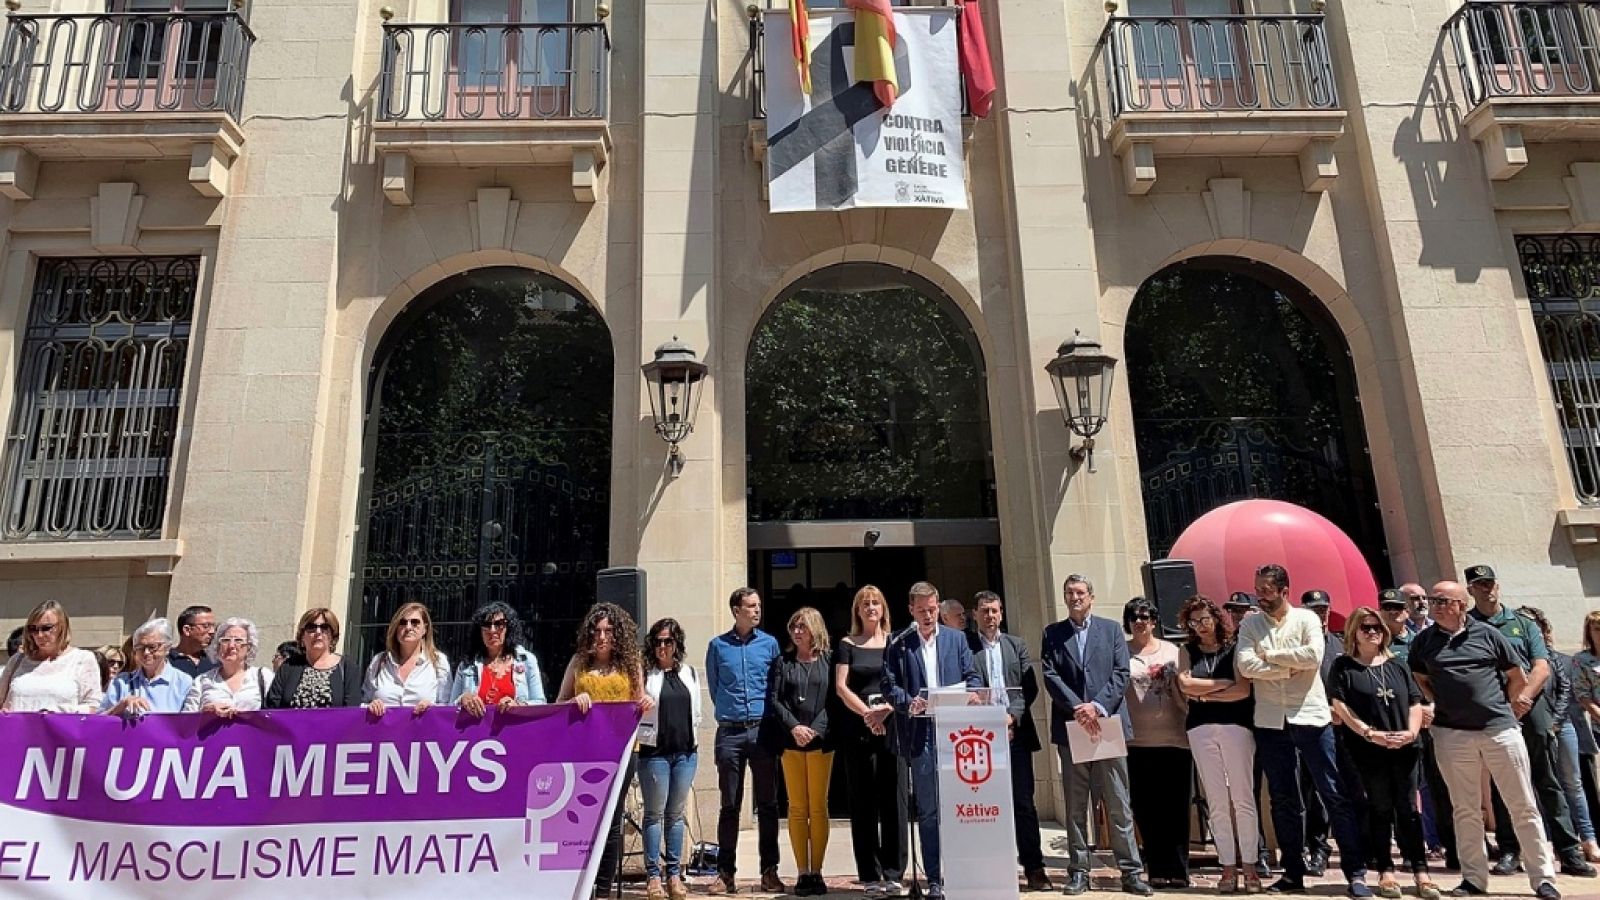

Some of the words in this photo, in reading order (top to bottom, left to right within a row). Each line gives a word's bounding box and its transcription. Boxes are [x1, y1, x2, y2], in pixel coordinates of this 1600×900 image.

[883, 114, 944, 133] CONTRA
[884, 135, 946, 156] VIOLÈNCIA
[885, 156, 948, 178] GÈNERE
[914, 194, 945, 204] XÀTIVA
[15, 746, 84, 800] NI
[103, 745, 248, 801] UNA
[269, 739, 508, 798] MENYS
[956, 803, 999, 817] Xàtiva
[0, 841, 53, 882] EL
[69, 835, 359, 882] MASCLISME
[373, 833, 501, 877] MATA
